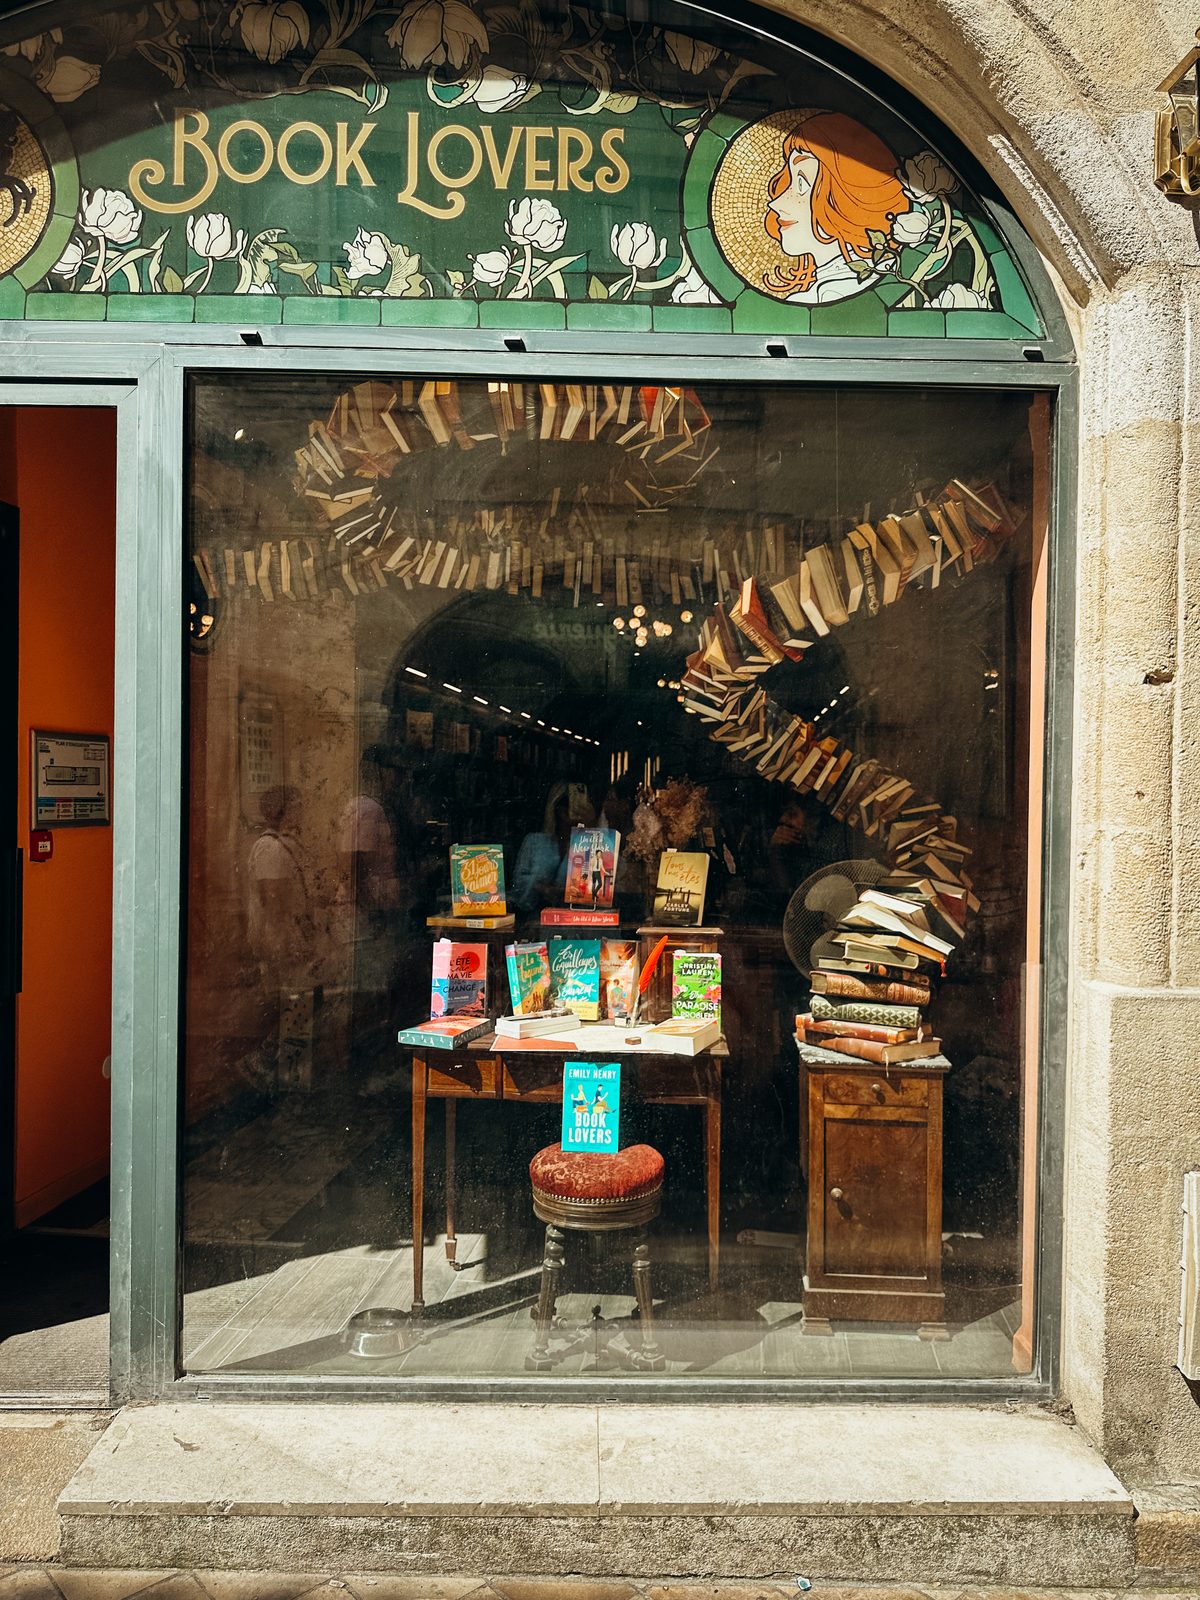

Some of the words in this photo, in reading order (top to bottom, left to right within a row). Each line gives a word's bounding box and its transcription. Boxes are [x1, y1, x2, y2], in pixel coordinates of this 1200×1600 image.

[128, 107, 379, 214] BOOK
[397, 111, 630, 220] LOVERS
[558, 944, 573, 960] Les
[450, 956, 471, 966] L'ÉTÉ
[678, 962, 717, 970] CHRISTINA
[460, 971, 473, 979] VIE
[442, 982, 477, 994] CHANGÉ
[676, 1000, 719, 1011] PARADISE
[680, 1011, 715, 1019] PROBLEM
[568, 1069, 591, 1079] EMILY
[593, 1070, 617, 1079] HENRY
[575, 1112, 607, 1128] BOOK
[568, 1127, 612, 1144] LOVERS
